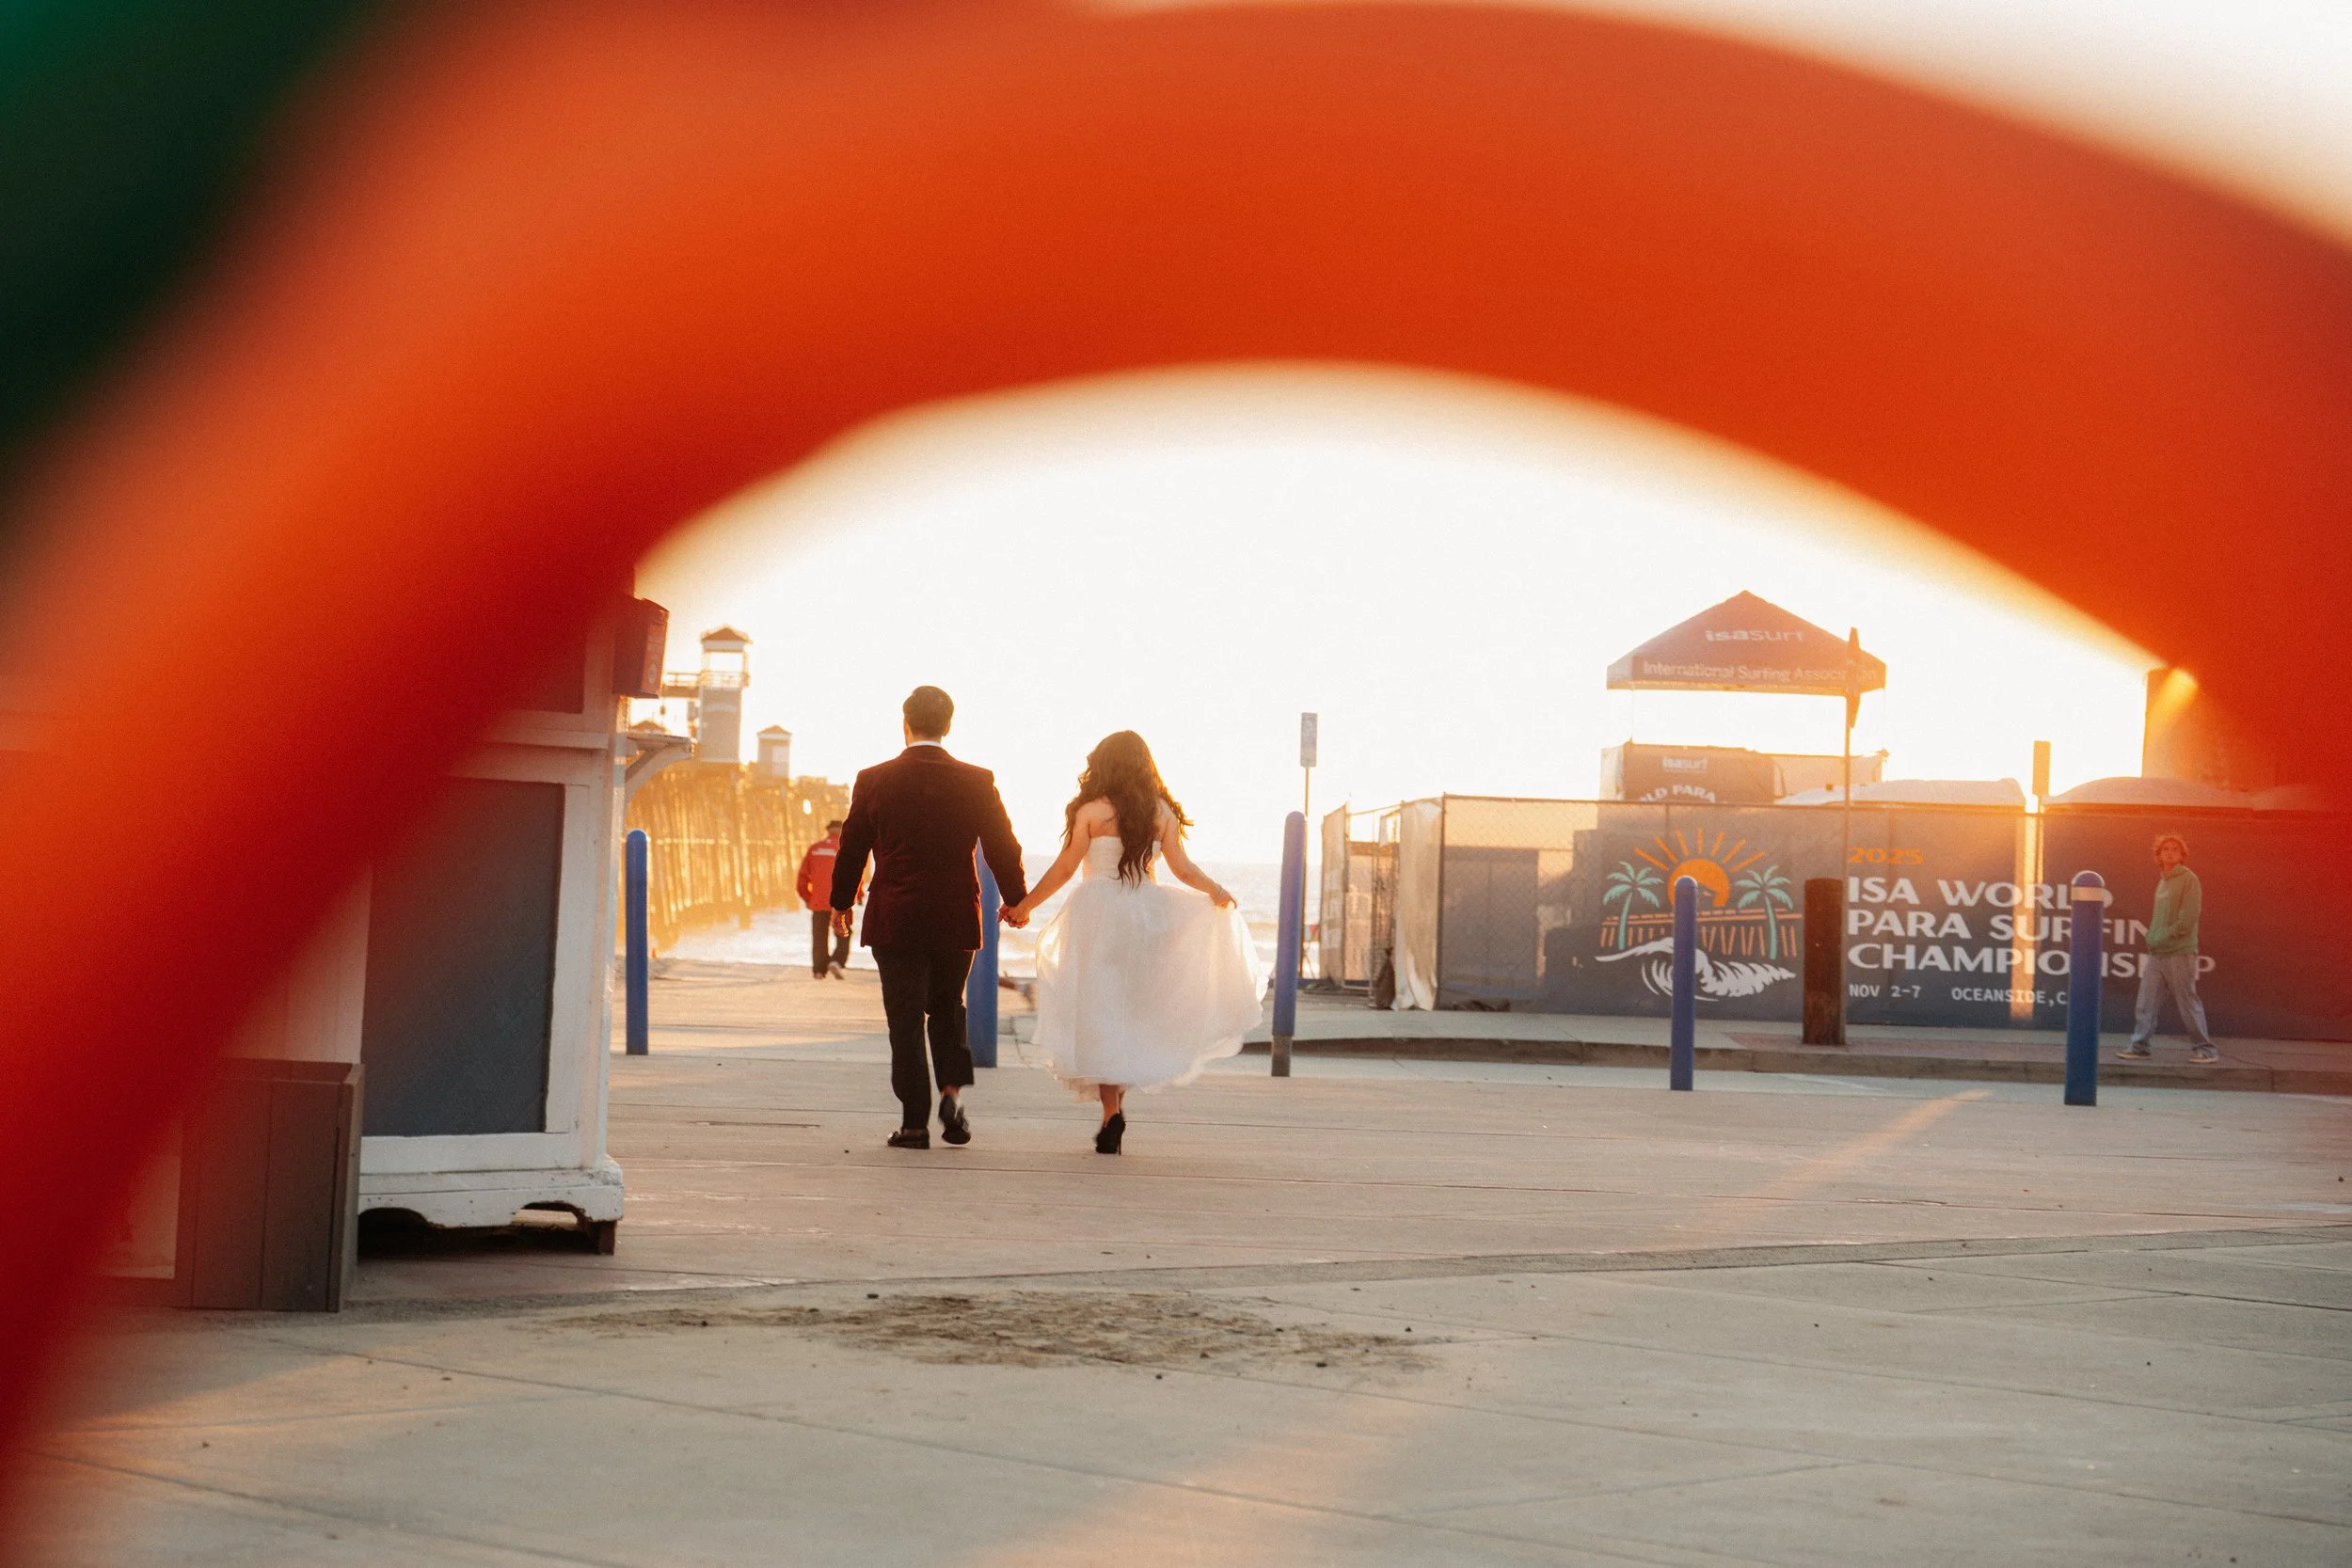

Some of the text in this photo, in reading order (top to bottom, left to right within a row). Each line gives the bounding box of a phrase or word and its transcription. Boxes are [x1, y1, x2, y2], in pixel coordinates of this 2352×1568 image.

[1644, 661, 1734, 677] International
[1738, 665, 1790, 682] Surfing
[1672, 784, 1716, 802] PARA
[1848, 847, 1924, 865] 2025
[1848, 876, 1920, 905] ISA
[1848, 909, 1972, 940] PARA
[1847, 943, 2216, 980] CHAMPIOSP
[1849, 984, 1881, 998] NOV
[1890, 985, 1922, 999] 2-7
